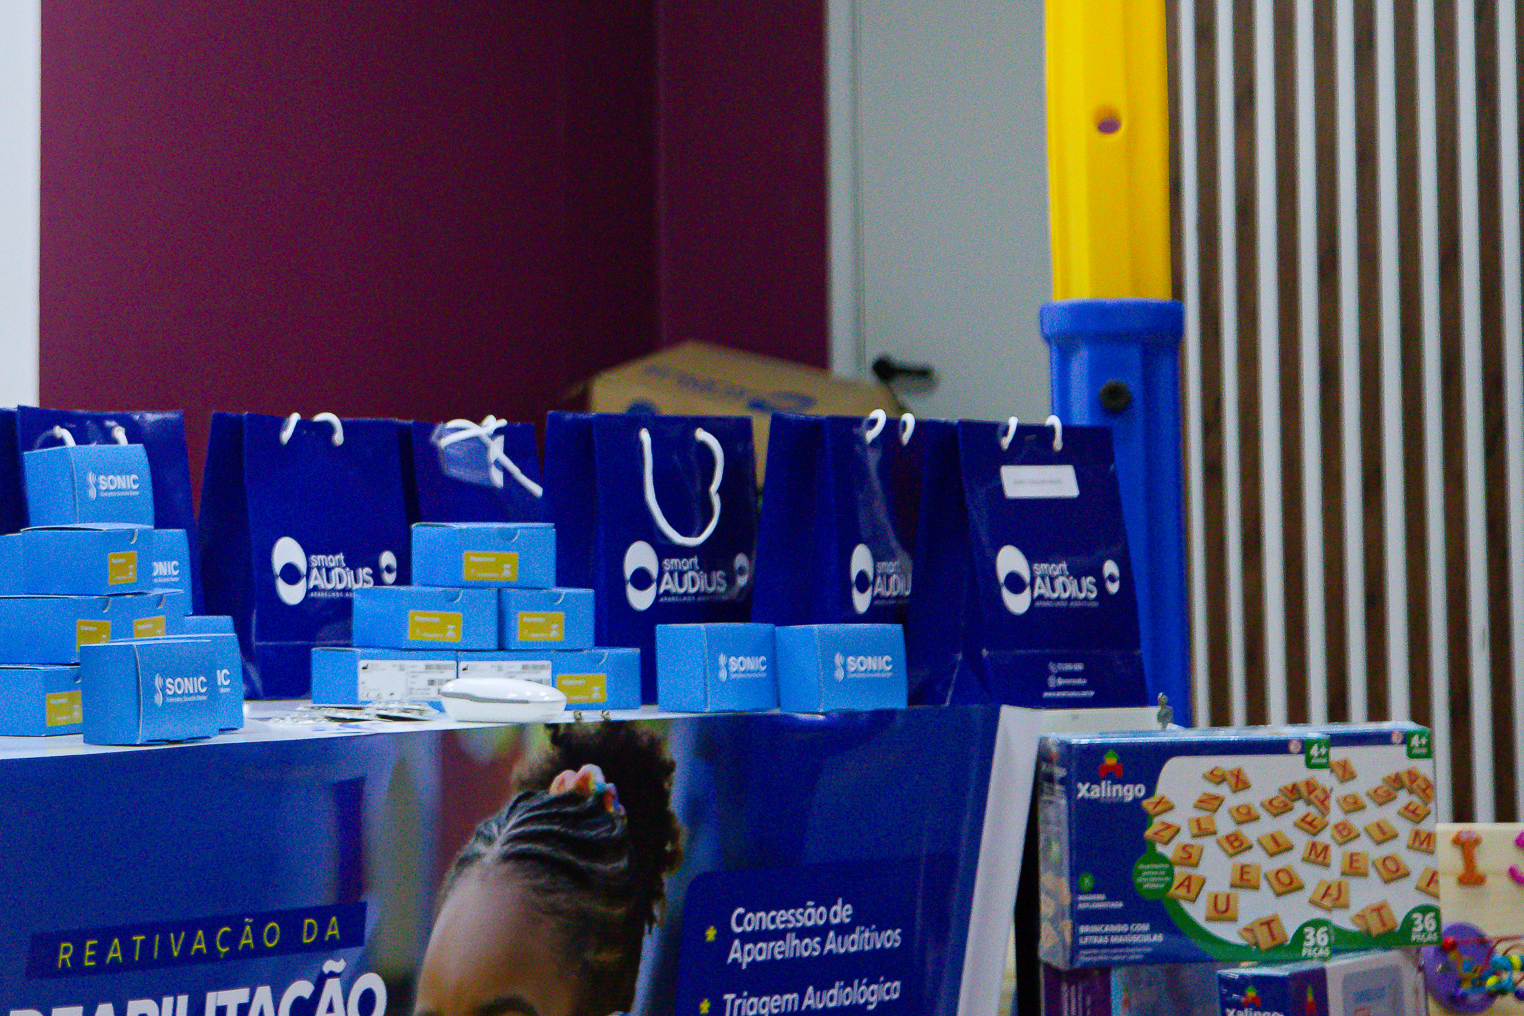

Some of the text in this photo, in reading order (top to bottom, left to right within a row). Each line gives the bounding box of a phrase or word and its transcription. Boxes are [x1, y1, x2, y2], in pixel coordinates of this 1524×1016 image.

[98, 473, 140, 491] SONIC
[152, 560, 180, 576] ONIC
[309, 552, 346, 567] smart
[662, 556, 700, 570] smart
[1033, 561, 1069, 576] smart
[728, 655, 767, 672] SONIC
[846, 654, 893, 672] SONIC
[165, 676, 208, 696] SONIC
[1076, 780, 1146, 803] Xalingo
[730, 898, 853, 934] Concessão de
[1411, 912, 1437, 933] 36
[58, 916, 340, 969] REATIVAÇÃO DA
[1303, 926, 1329, 947] 36
[727, 925, 902, 969] Aparelhos Auditivos
[723, 977, 902, 1016] Triagem Audiológica
